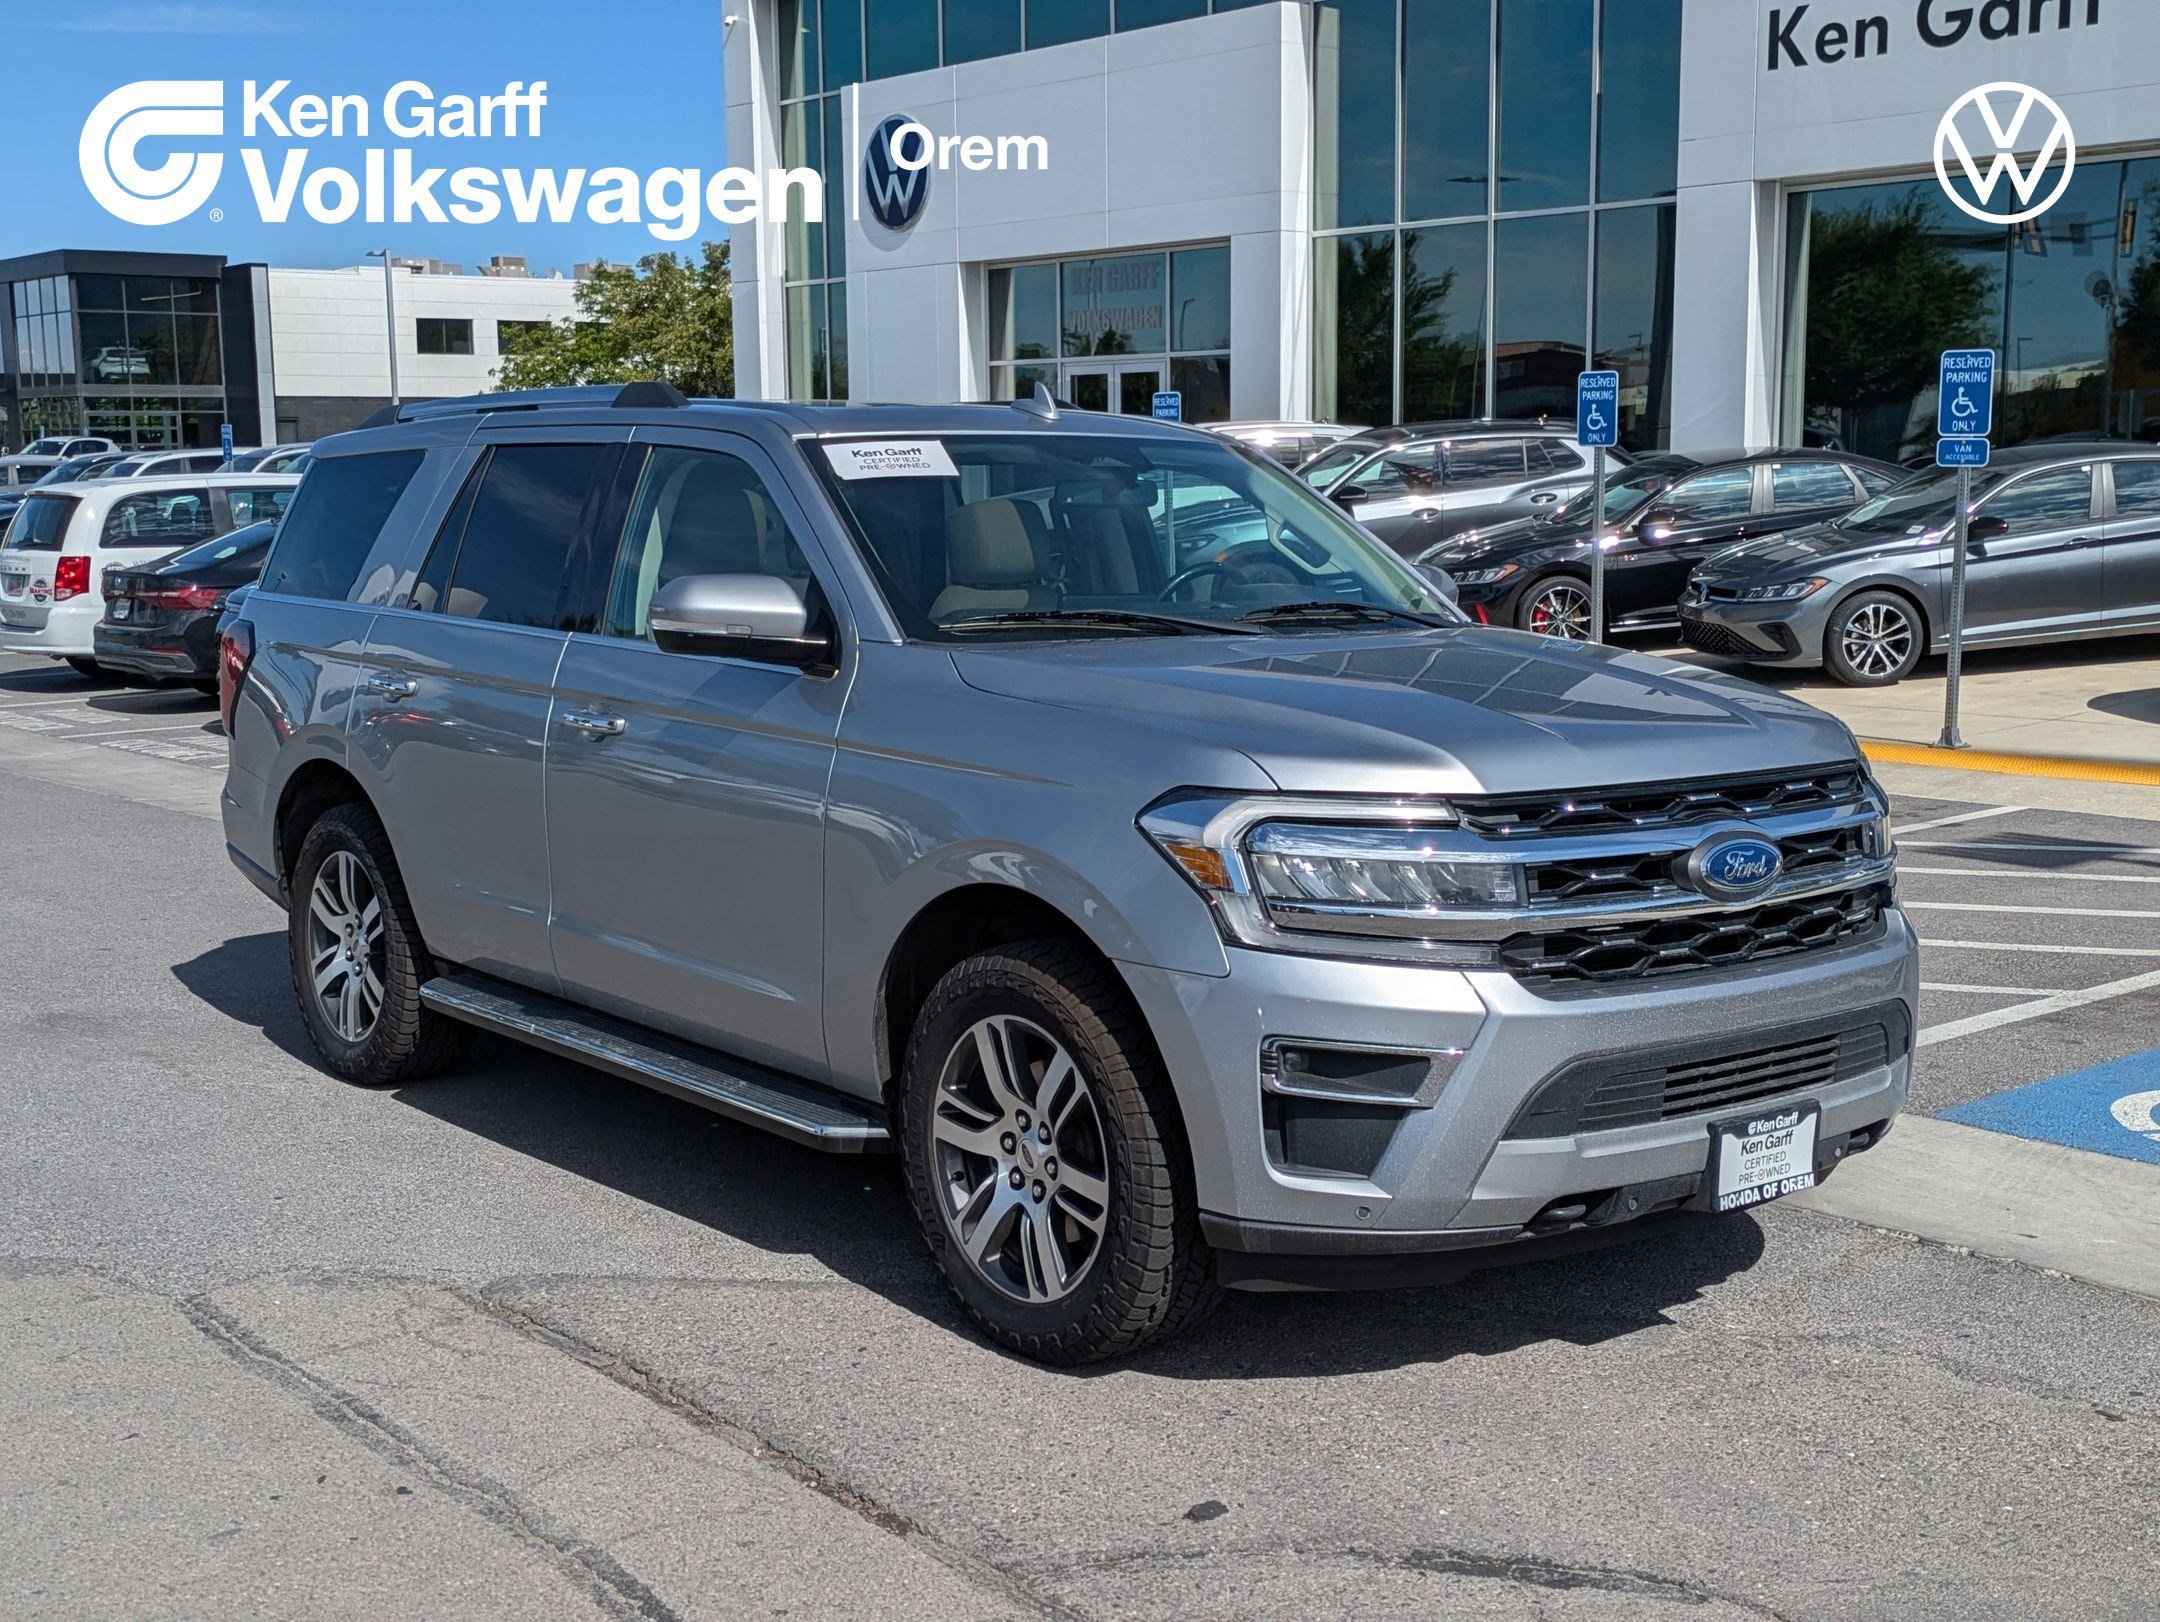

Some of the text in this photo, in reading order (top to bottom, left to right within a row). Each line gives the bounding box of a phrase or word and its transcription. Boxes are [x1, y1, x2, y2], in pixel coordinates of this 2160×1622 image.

[1767, 4, 1889, 71] Ken
[1944, 357, 1991, 369] RESERVED
[1580, 377, 1616, 388] RESERVED
[1945, 372, 1987, 383] PARKING
[1582, 390, 1614, 401] PARKING
[1952, 420, 1976, 432] ONLY
[1587, 433, 1606, 443] ONLY
[851, 447, 922, 458] Ken Garff
[1954, 444, 1972, 453] VAN
[863, 456, 921, 465] CERTIFIED
[1945, 453, 1980, 461] ACCESSIBLE
[1724, 850, 1767, 880] Ford
[1756, 1111, 1799, 1134] Ken Garff
[1740, 1129, 1794, 1156] Ken Garff
[1744, 1151, 1787, 1170] CERTIFIED
[1720, 1173, 1814, 1212] HONDA OF OREM
